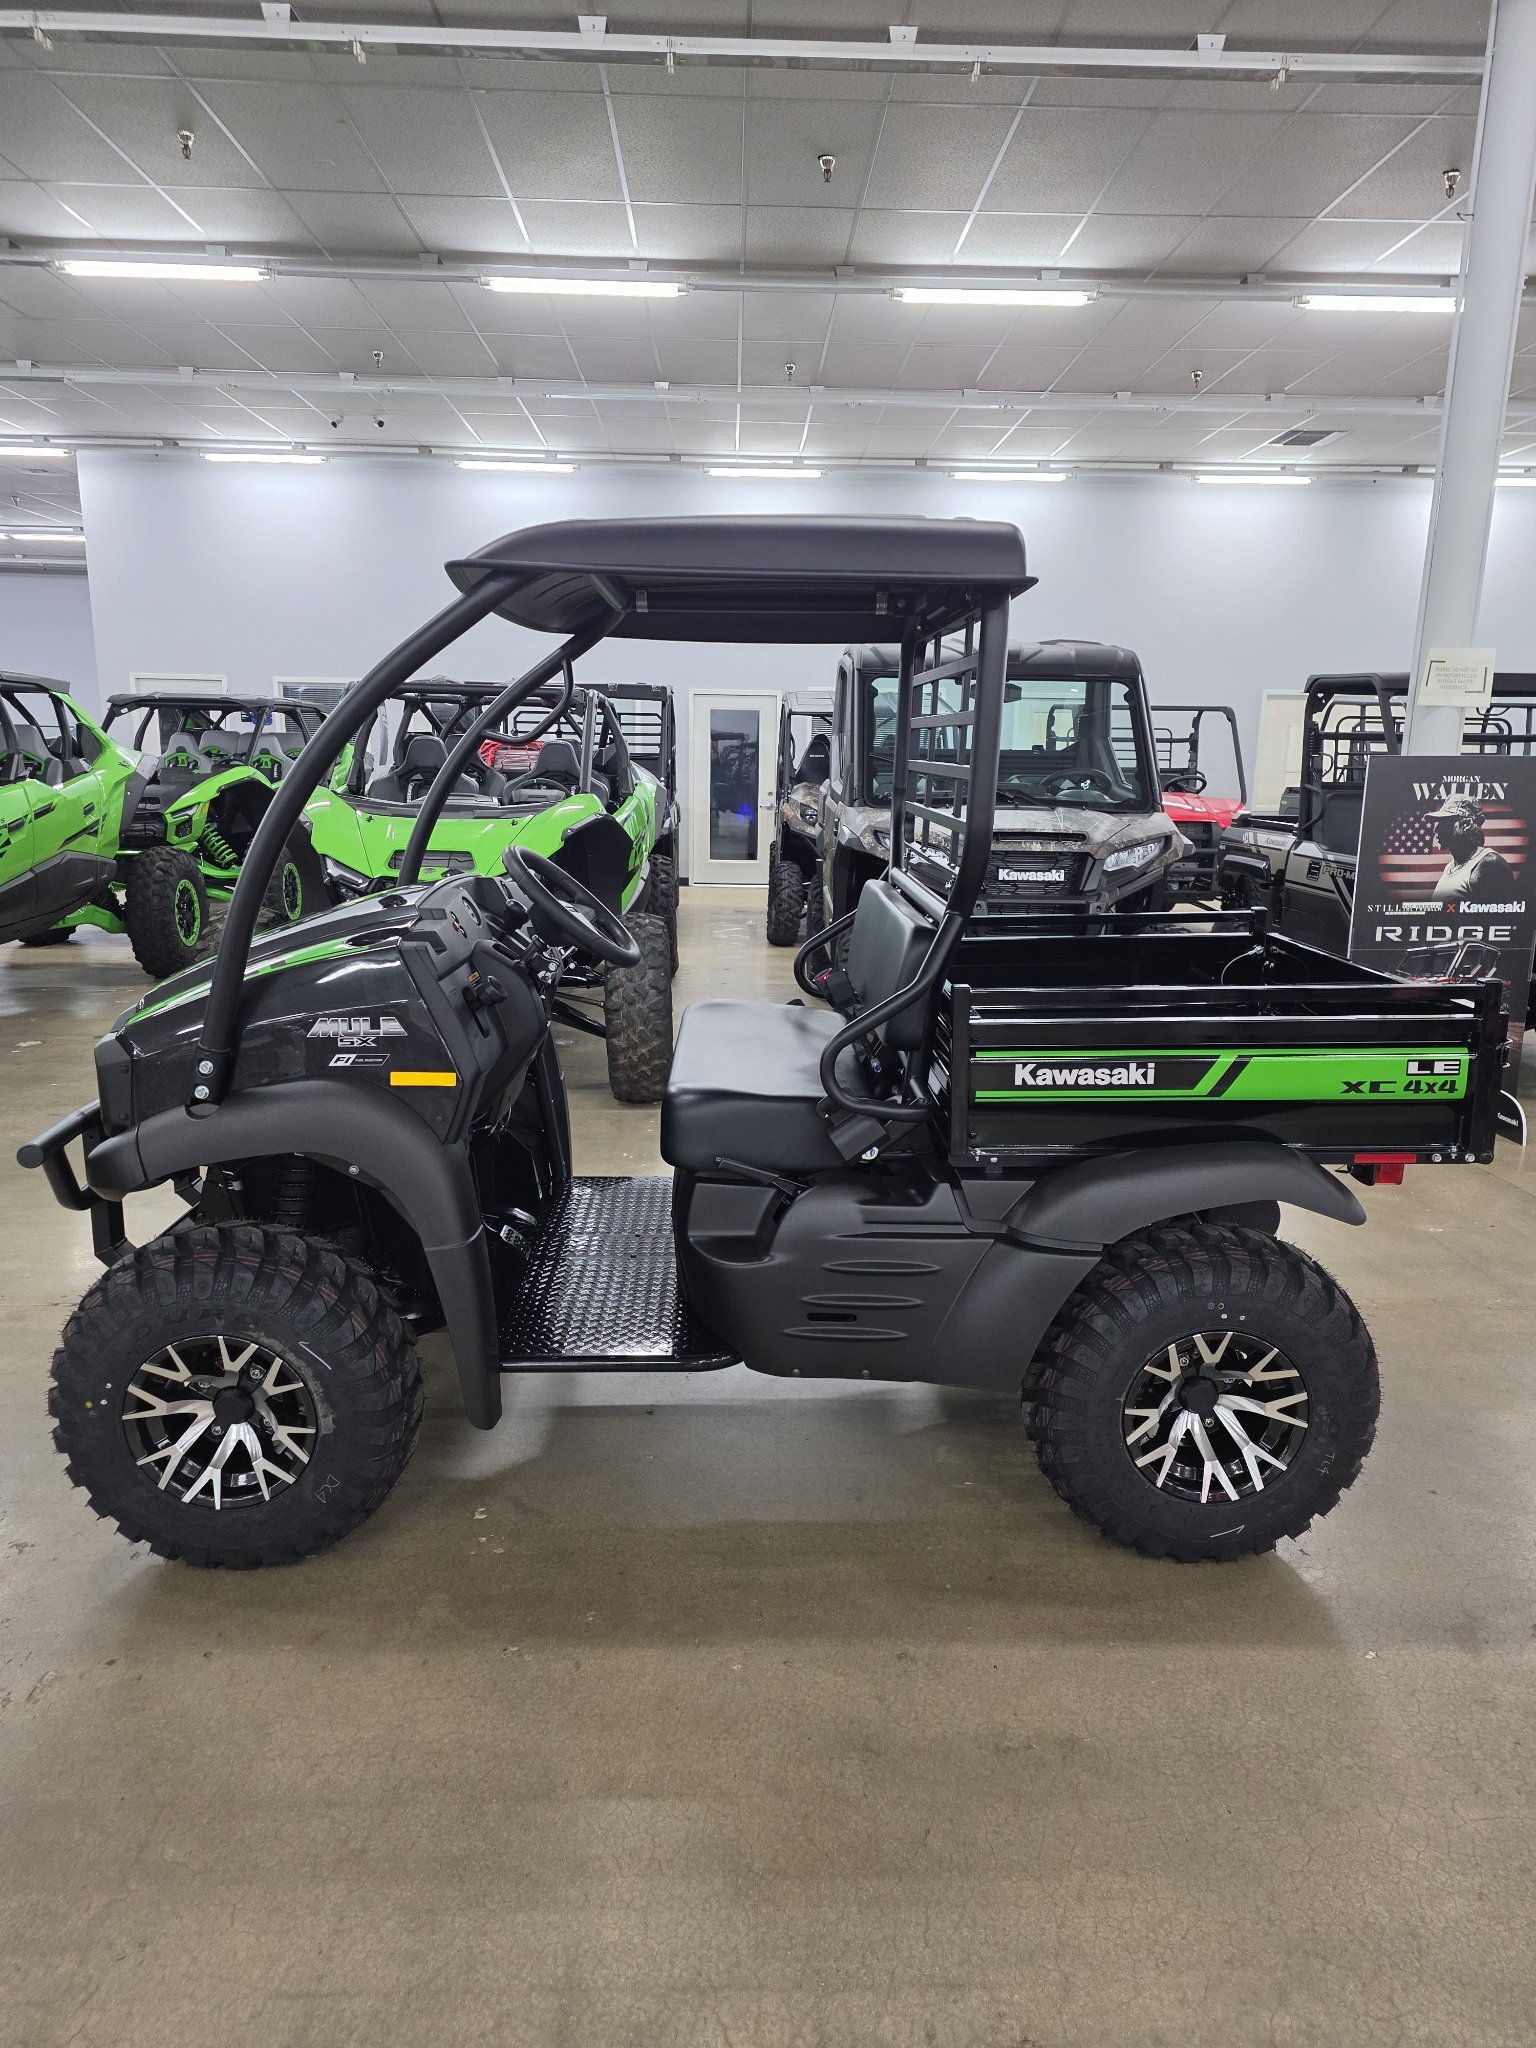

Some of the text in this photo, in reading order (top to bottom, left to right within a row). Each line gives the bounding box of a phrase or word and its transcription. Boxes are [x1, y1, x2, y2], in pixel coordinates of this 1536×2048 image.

[1442, 775, 1481, 783] MORGAN
[1413, 783, 1509, 801] WALLEN
[998, 869, 1064, 881] Kawasaki
[1367, 904, 1401, 912] STILL
[1459, 901, 1526, 913] Kawasaki
[1375, 925, 1511, 942] RIDGE
[307, 1017, 408, 1037] MULE
[338, 1037, 378, 1047] SX
[1407, 1060, 1460, 1074] LE
[1014, 1063, 1155, 1086] Kawasaki
[1340, 1079, 1458, 1094] XC 4x4
